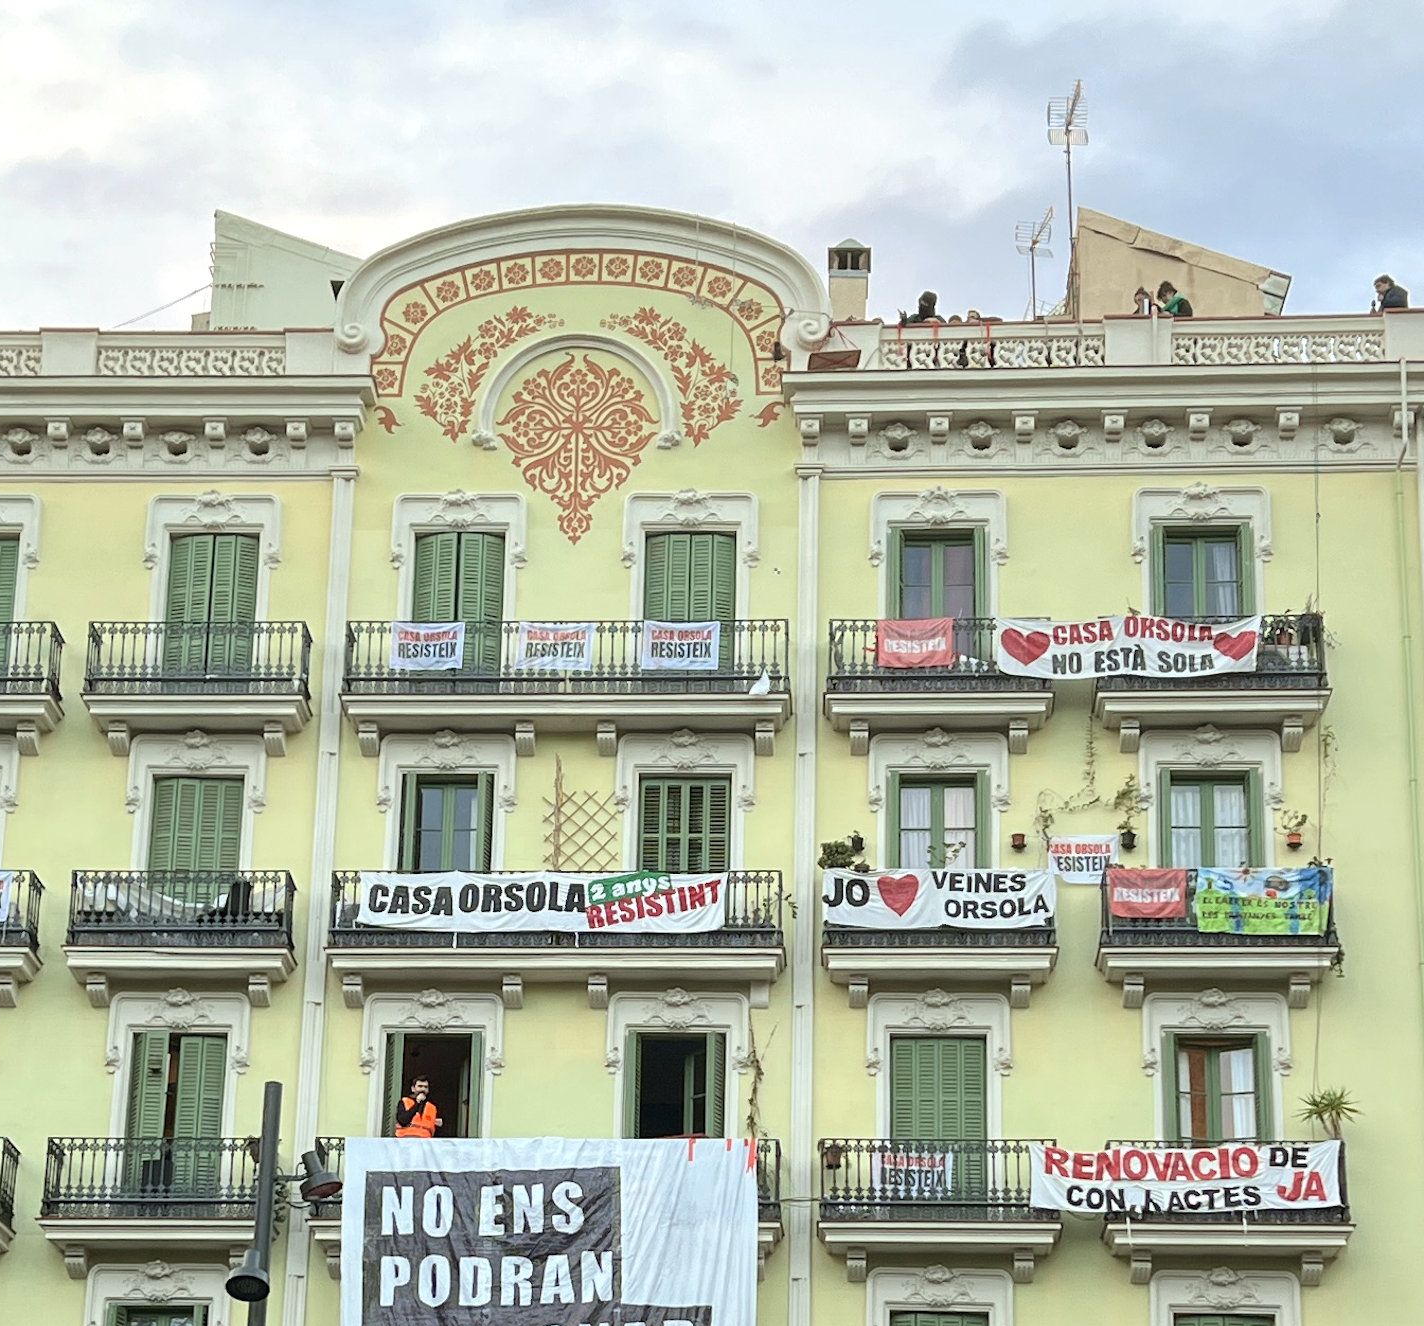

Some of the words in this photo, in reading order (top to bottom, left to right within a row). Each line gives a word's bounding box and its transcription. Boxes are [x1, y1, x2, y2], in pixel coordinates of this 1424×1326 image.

[398, 631, 422, 641] CASA
[424, 631, 458, 642] ORSOLA
[527, 630, 550, 641] CASA
[553, 631, 586, 641] ORSOLA
[651, 629, 675, 641] CASA
[677, 629, 712, 641] ORSOLA
[1052, 620, 1115, 645] CASA
[1124, 615, 1215, 643] ORSOLA
[398, 642, 457, 659] RESISTEIX
[526, 641, 585, 659] RESISTEIX
[651, 641, 712, 659] RESISTEIX
[1052, 652, 1082, 675] NO
[1094, 644, 1147, 674] ESTÀ
[1158, 651, 1215, 673] SOLA
[1075, 843, 1111, 854] ORSOLA
[1053, 855, 1111, 872] ESISTEI
[368, 884, 454, 915] CASA
[458, 881, 587, 913] ORSOLA
[590, 883, 606, 900] 2
[612, 874, 672, 899] anys
[822, 877, 871, 908] JO
[586, 880, 722, 929] RESISTINT
[944, 894, 1050, 919] ORSOLA
[882, 1154, 905, 1166] AA
[1269, 1147, 1308, 1169] DE
[881, 1167, 945, 1187] ESISTEIX
[1277, 1171, 1328, 1202] JA
[381, 1185, 454, 1238] NO
[479, 1180, 585, 1238] ENS
[1065, 1185, 1262, 1213] CONACTES
[379, 1249, 615, 1307] PODRAN
